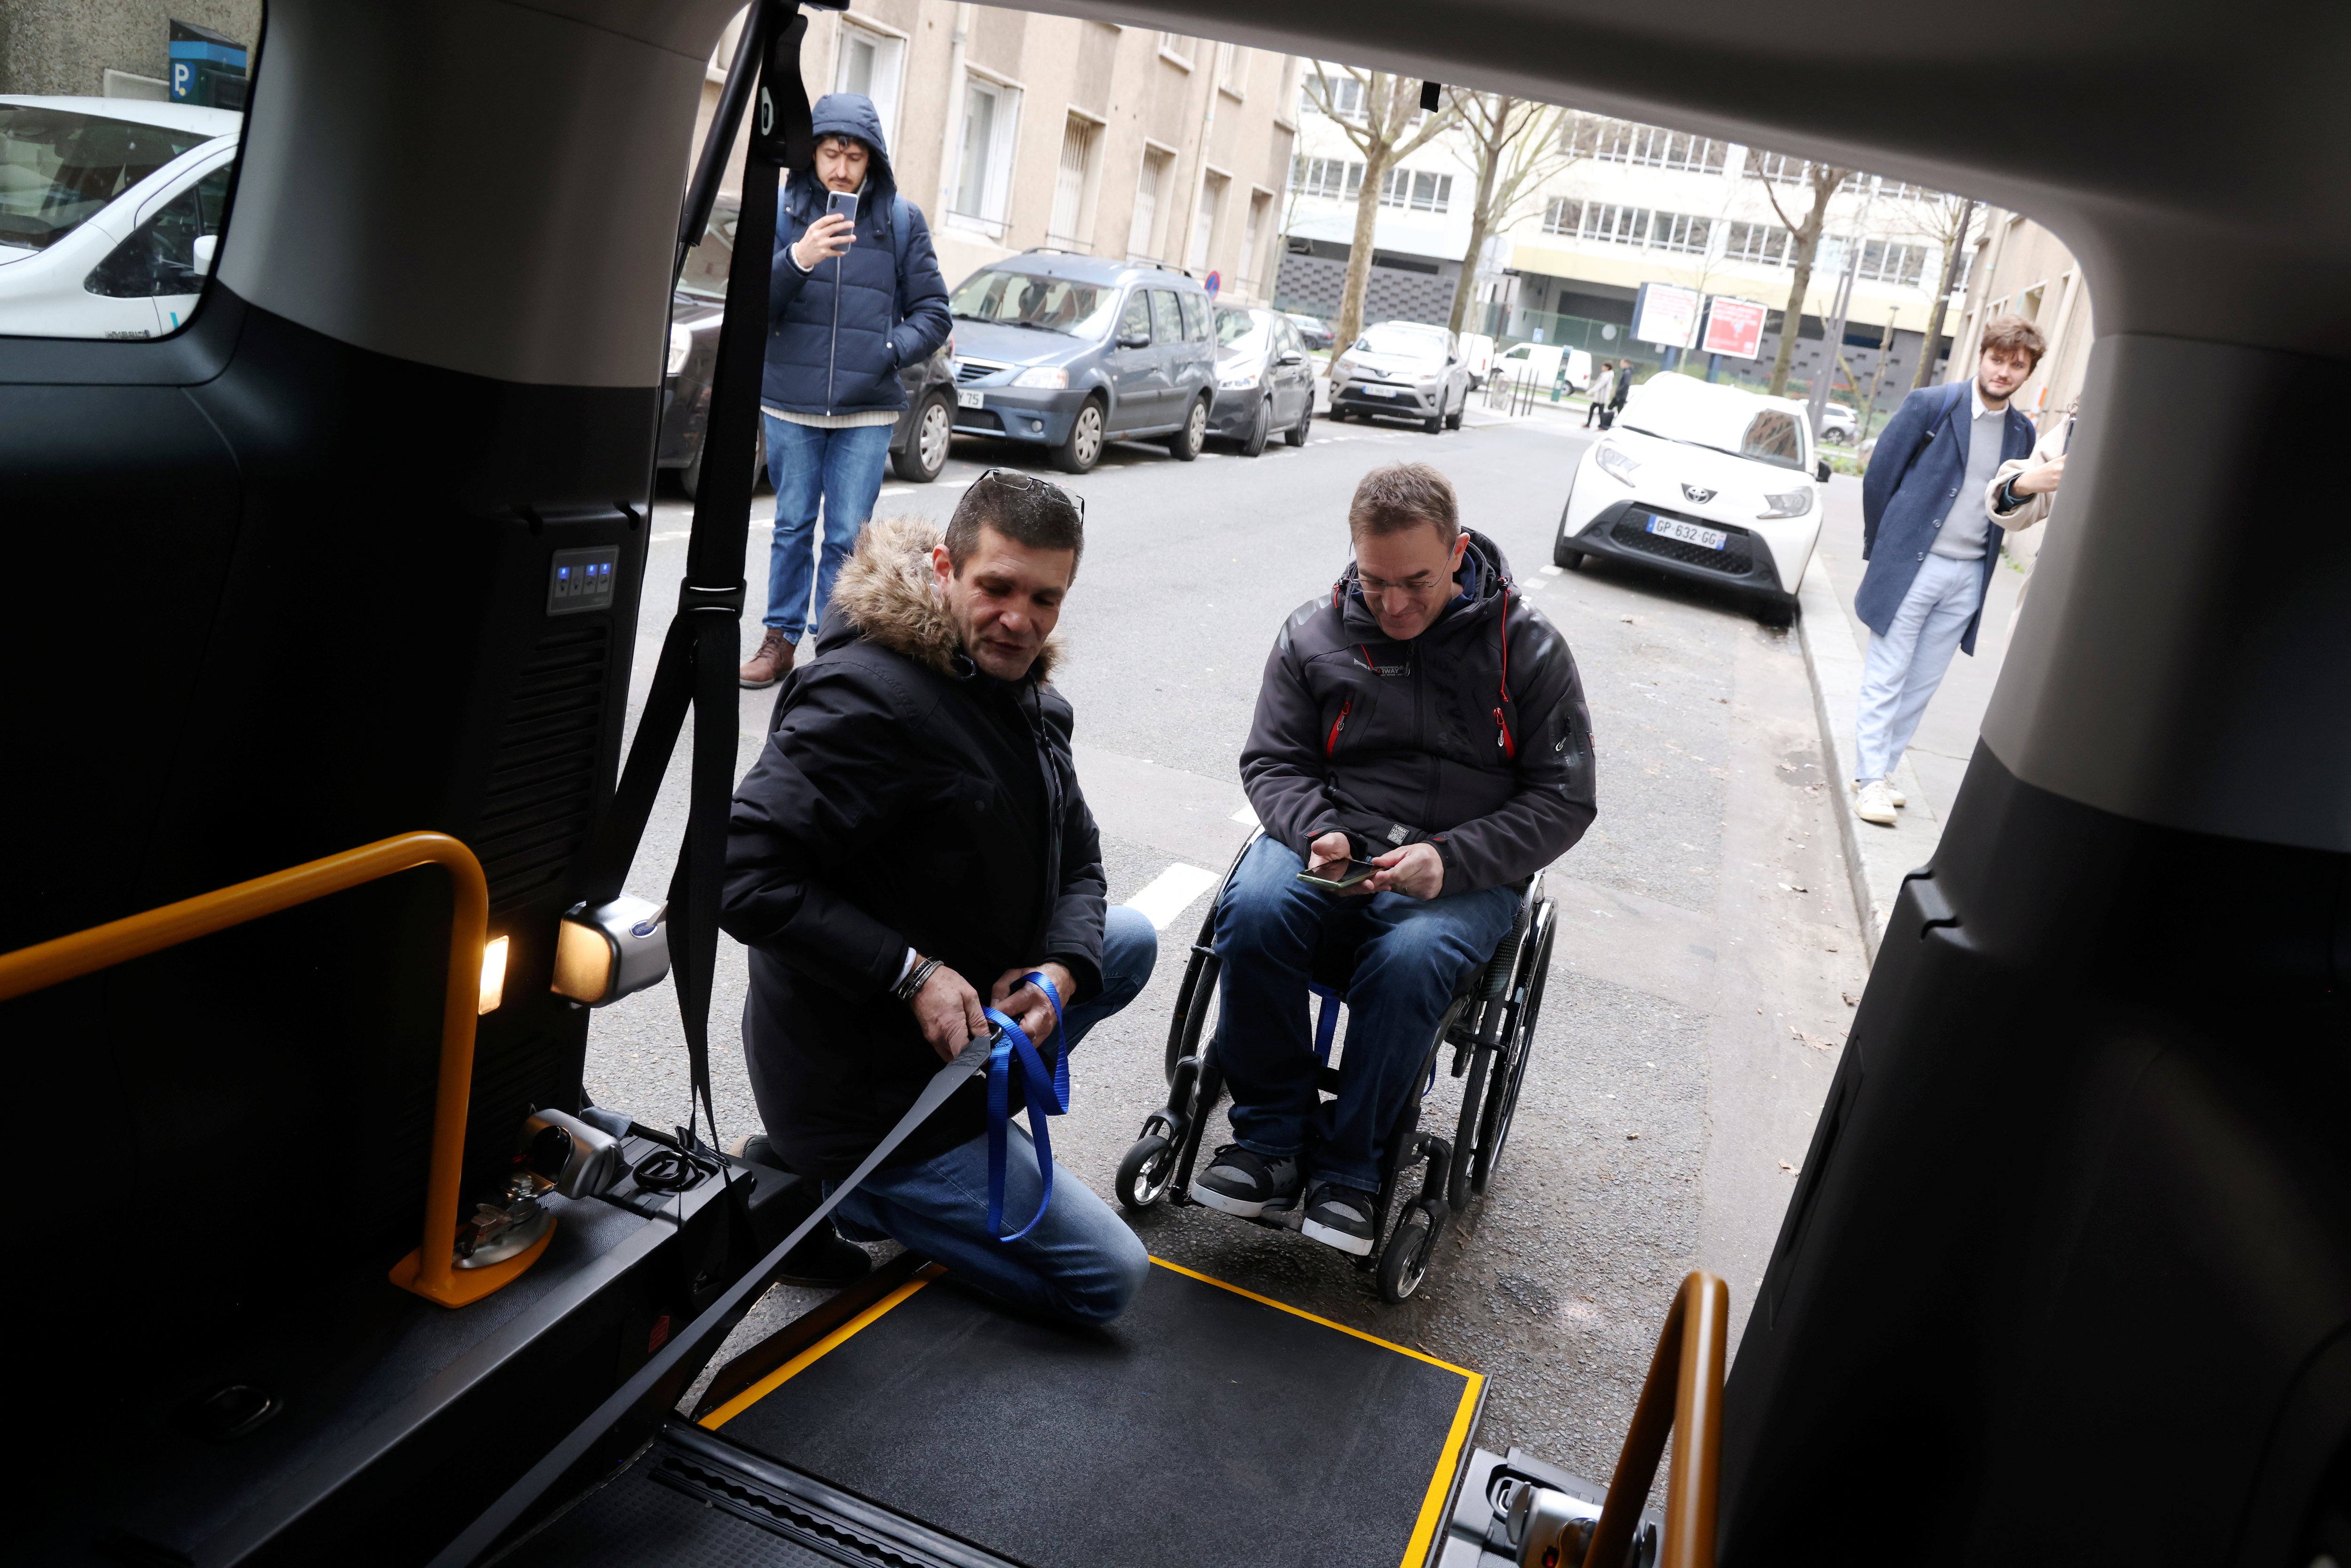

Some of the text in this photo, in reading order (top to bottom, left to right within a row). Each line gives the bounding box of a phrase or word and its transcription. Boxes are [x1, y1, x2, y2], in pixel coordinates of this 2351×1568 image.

[175, 63, 189, 92] P
[966, 393, 978, 405] 75
[1657, 520, 1717, 544] GP-632-GG
